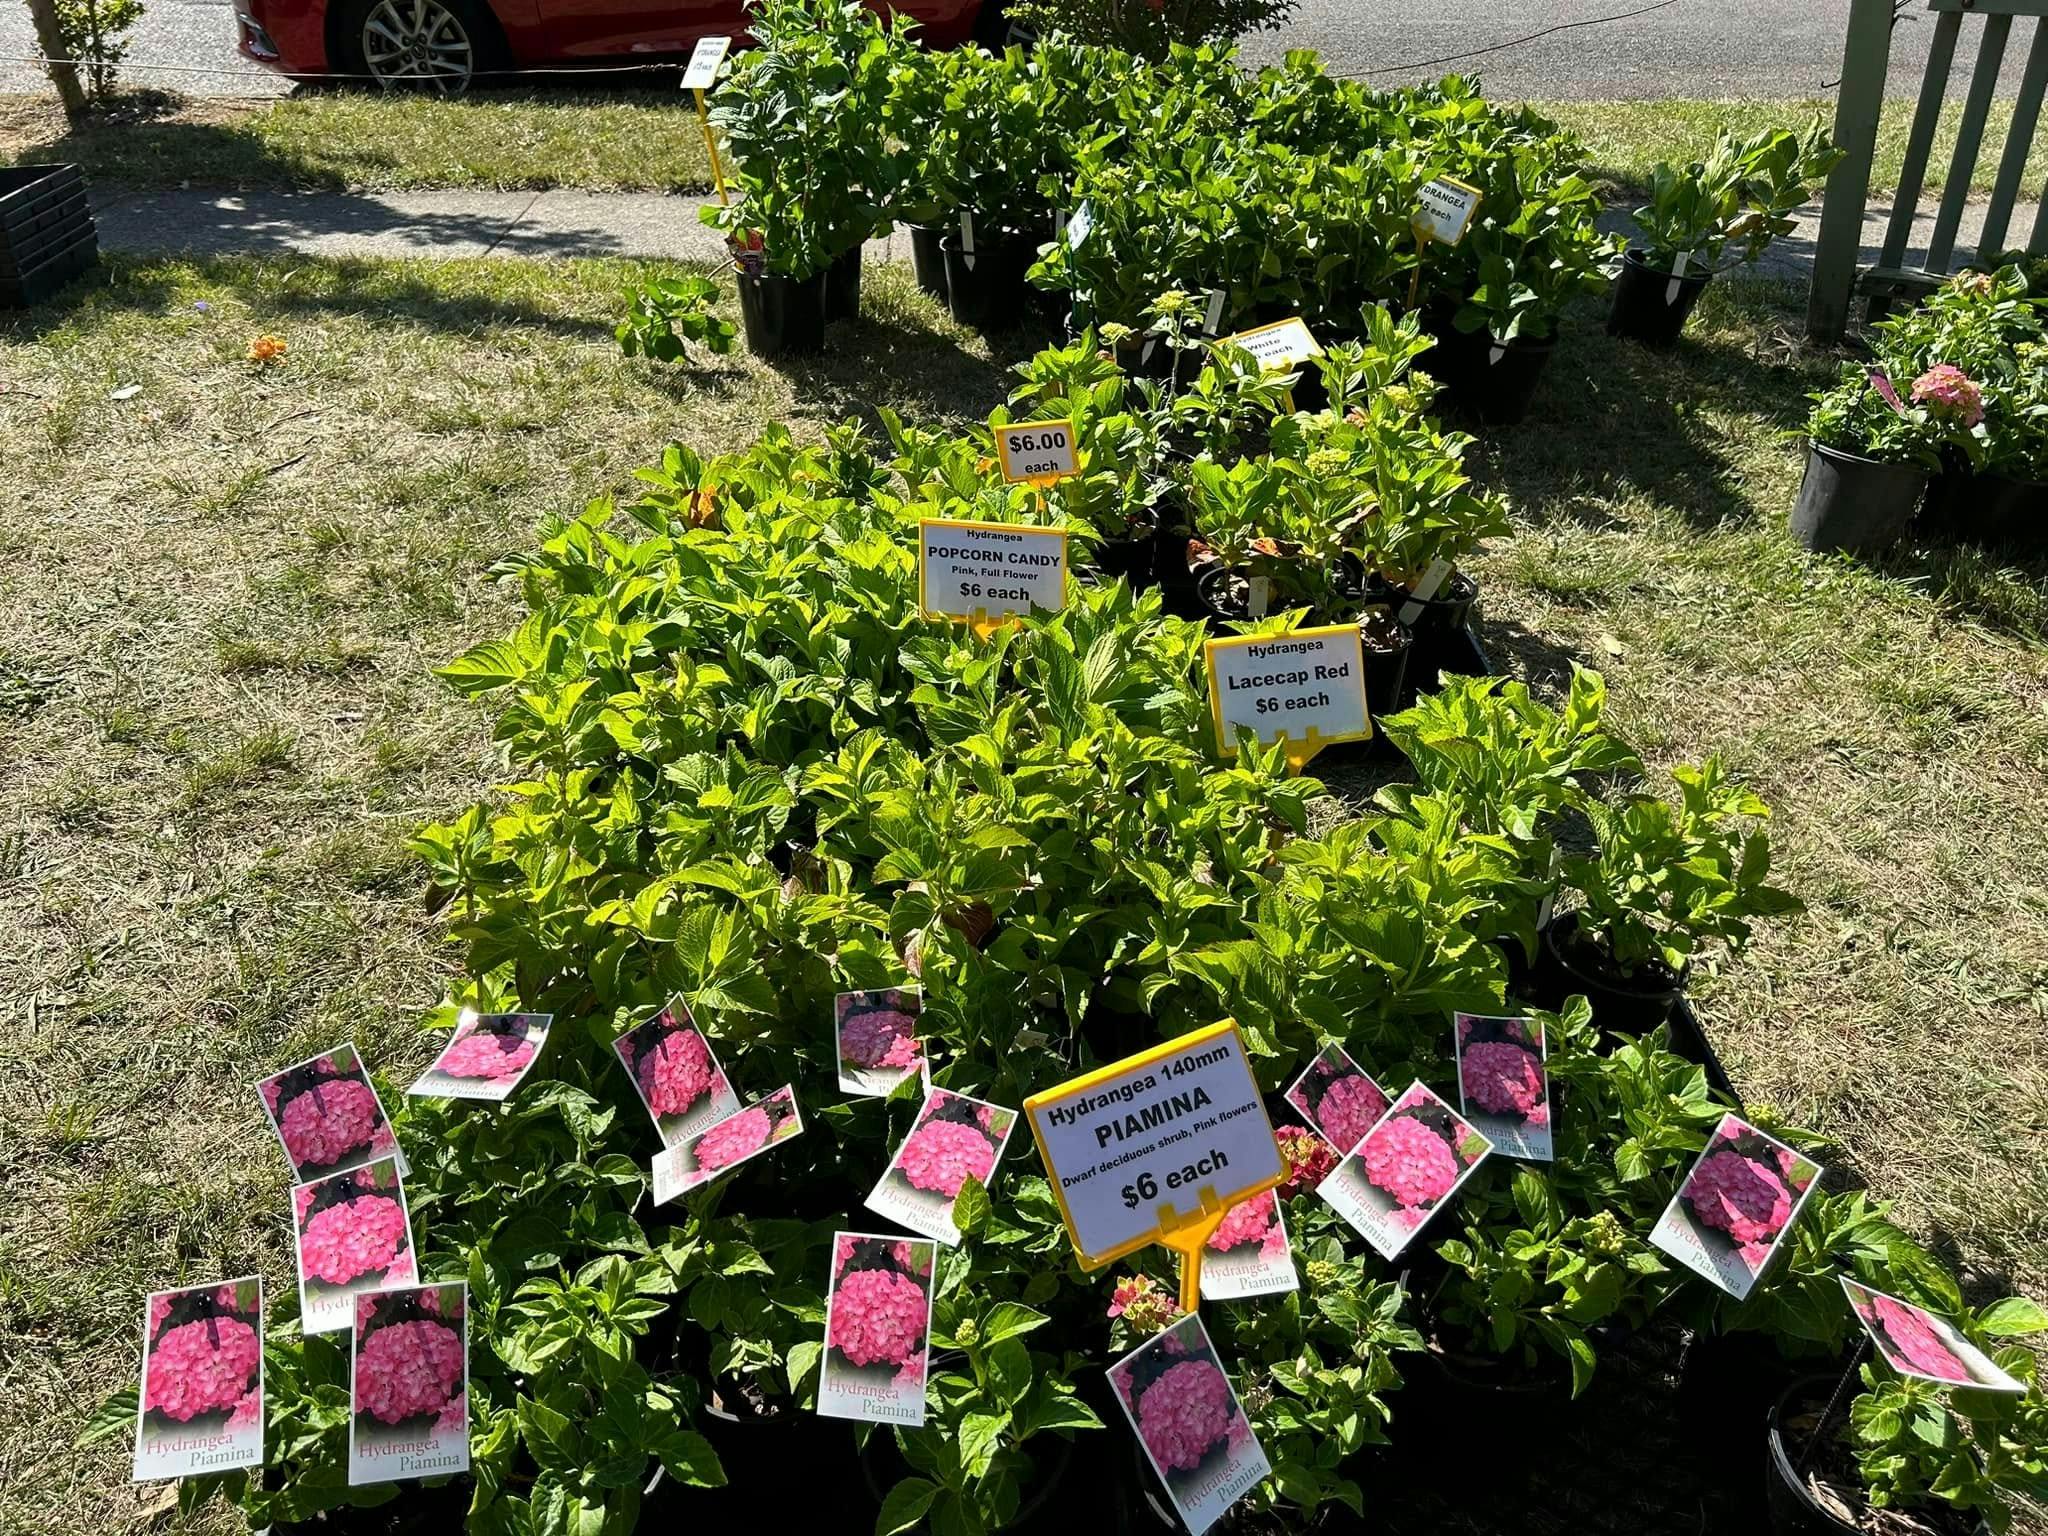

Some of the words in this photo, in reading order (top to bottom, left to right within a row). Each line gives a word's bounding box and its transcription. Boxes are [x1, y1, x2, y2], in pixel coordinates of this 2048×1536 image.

[1420, 185, 1466, 210] DRANGEA
[1430, 207, 1452, 221] each
[1247, 338, 1281, 351] White
[1264, 344, 1294, 357] each
[1009, 432, 1066, 454] $6.00
[1025, 460, 1059, 473] each
[967, 529, 1023, 543] Hydrangea
[928, 546, 1003, 562] POPCORN
[1008, 552, 1060, 567] CANDY
[952, 565, 978, 577] Pink,
[981, 568, 1000, 577] Full
[1003, 569, 1038, 580] Flower
[960, 582, 981, 597] $6
[987, 586, 1030, 601] each
[1248, 640, 1324, 659] Hydrangea
[1228, 671, 1309, 690] Lacecap
[1314, 662, 1349, 680] Red
[1256, 697, 1279, 714] $6
[1285, 691, 1330, 710] each
[1048, 1075, 1157, 1128] Hydrangea
[1161, 1046, 1230, 1081] 140mm
[1094, 1086, 1212, 1149] PIAMINA
[1062, 1164, 1098, 1188] Dwarf
[1099, 1142, 1156, 1174] deciduous
[1158, 1128, 1192, 1149] shrub,
[1193, 1117, 1218, 1135] Pink
[1219, 1100, 1258, 1123] flowers
[1500, 1138, 1546, 1156] Piamina
[1121, 1172, 1158, 1210] $6
[1166, 1149, 1229, 1190] each
[881, 1187, 944, 1220] Hydrangea
[1336, 1174, 1389, 1228] Hydrangea
[1352, 1208, 1392, 1250] Piamina
[1667, 1220, 1732, 1268] Hydrangea
[1203, 1262, 1270, 1282] Hydrangea
[1692, 1250, 1741, 1290] Piamina
[1240, 1273, 1291, 1291] Piamina
[829, 1377, 899, 1401] Hydrangea
[863, 1398, 917, 1418] Piamina
[147, 1433, 233, 1458] Hydrangea
[190, 1446, 254, 1467] Piamina
[360, 1439, 440, 1461] Hydrangea
[400, 1452, 460, 1471] Piamina
[1182, 1460, 1241, 1511] Hydrangea
[1217, 1462, 1262, 1502] Piamina
